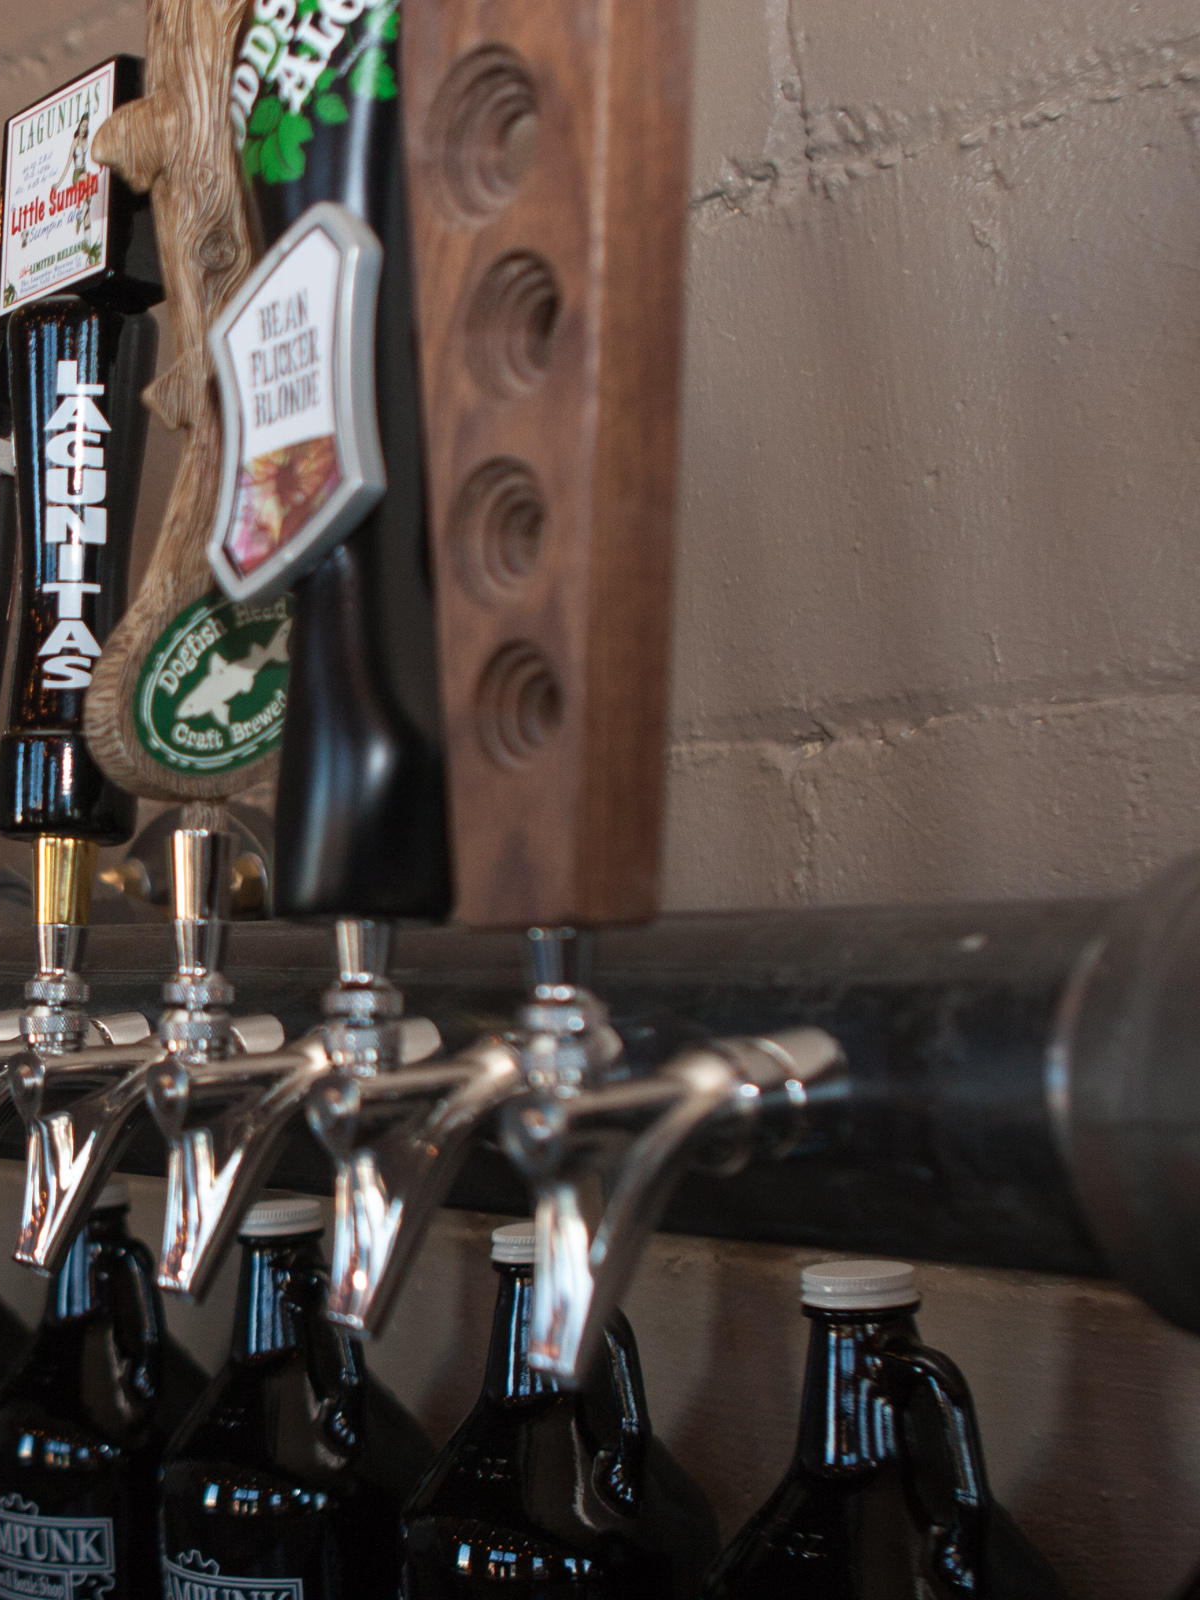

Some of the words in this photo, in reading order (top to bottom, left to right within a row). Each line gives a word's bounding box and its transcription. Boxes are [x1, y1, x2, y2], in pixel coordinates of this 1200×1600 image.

[18, 82, 100, 155] LAGUNITAS
[11, 195, 46, 236] Little
[259, 287, 309, 342] BEAN
[251, 326, 320, 388] FLICKER
[254, 369, 320, 429] BLONDE
[38, 359, 112, 690] LAGUNITAS
[158, 617, 228, 697] Dogfish
[171, 722, 224, 750] Craft
